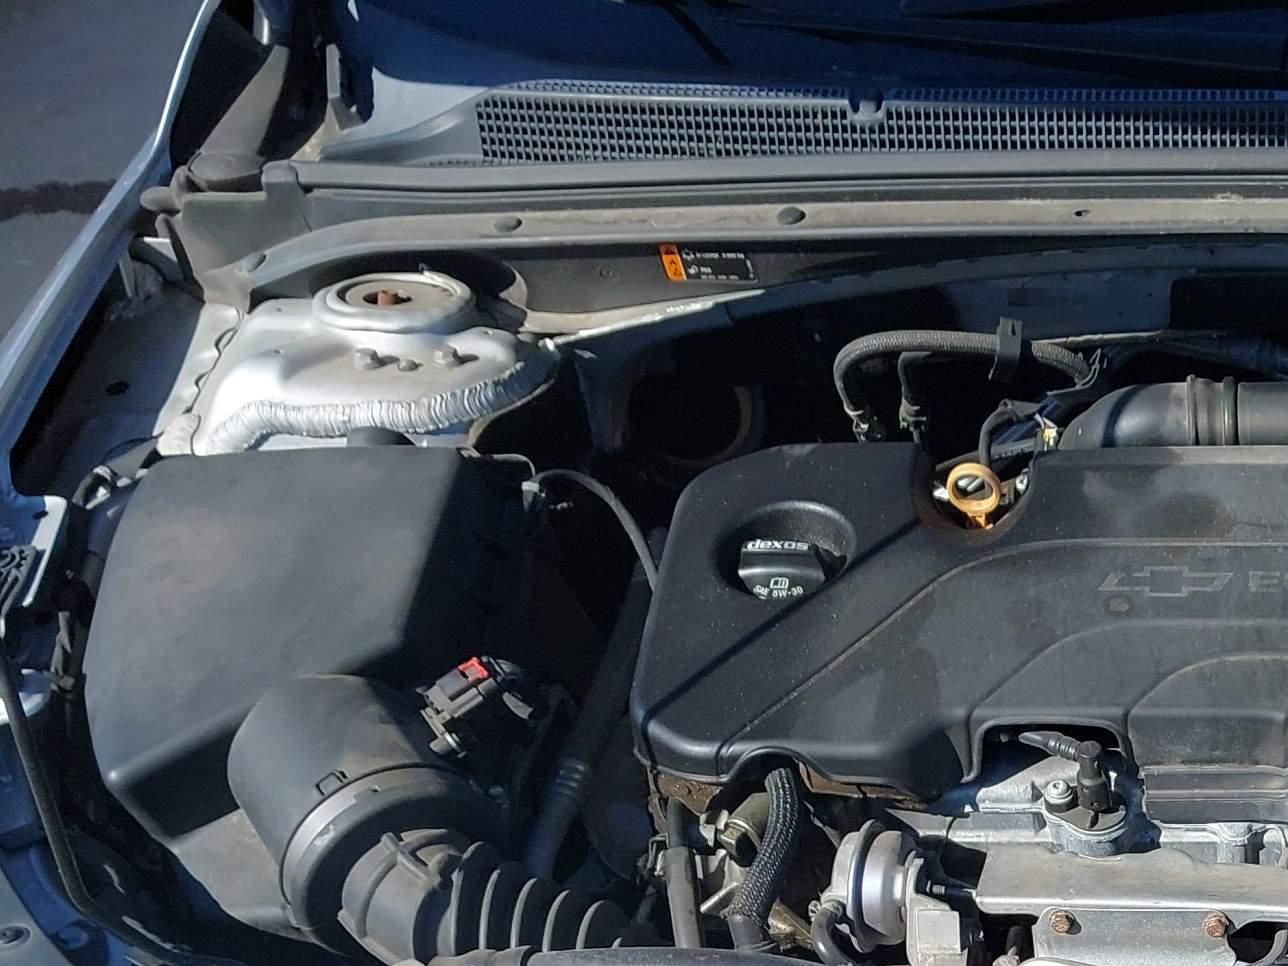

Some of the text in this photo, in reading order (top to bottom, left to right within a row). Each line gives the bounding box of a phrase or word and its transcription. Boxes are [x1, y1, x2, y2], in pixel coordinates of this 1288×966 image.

[747, 539, 809, 550] dexos
[753, 584, 804, 599] SAE 5W-30
